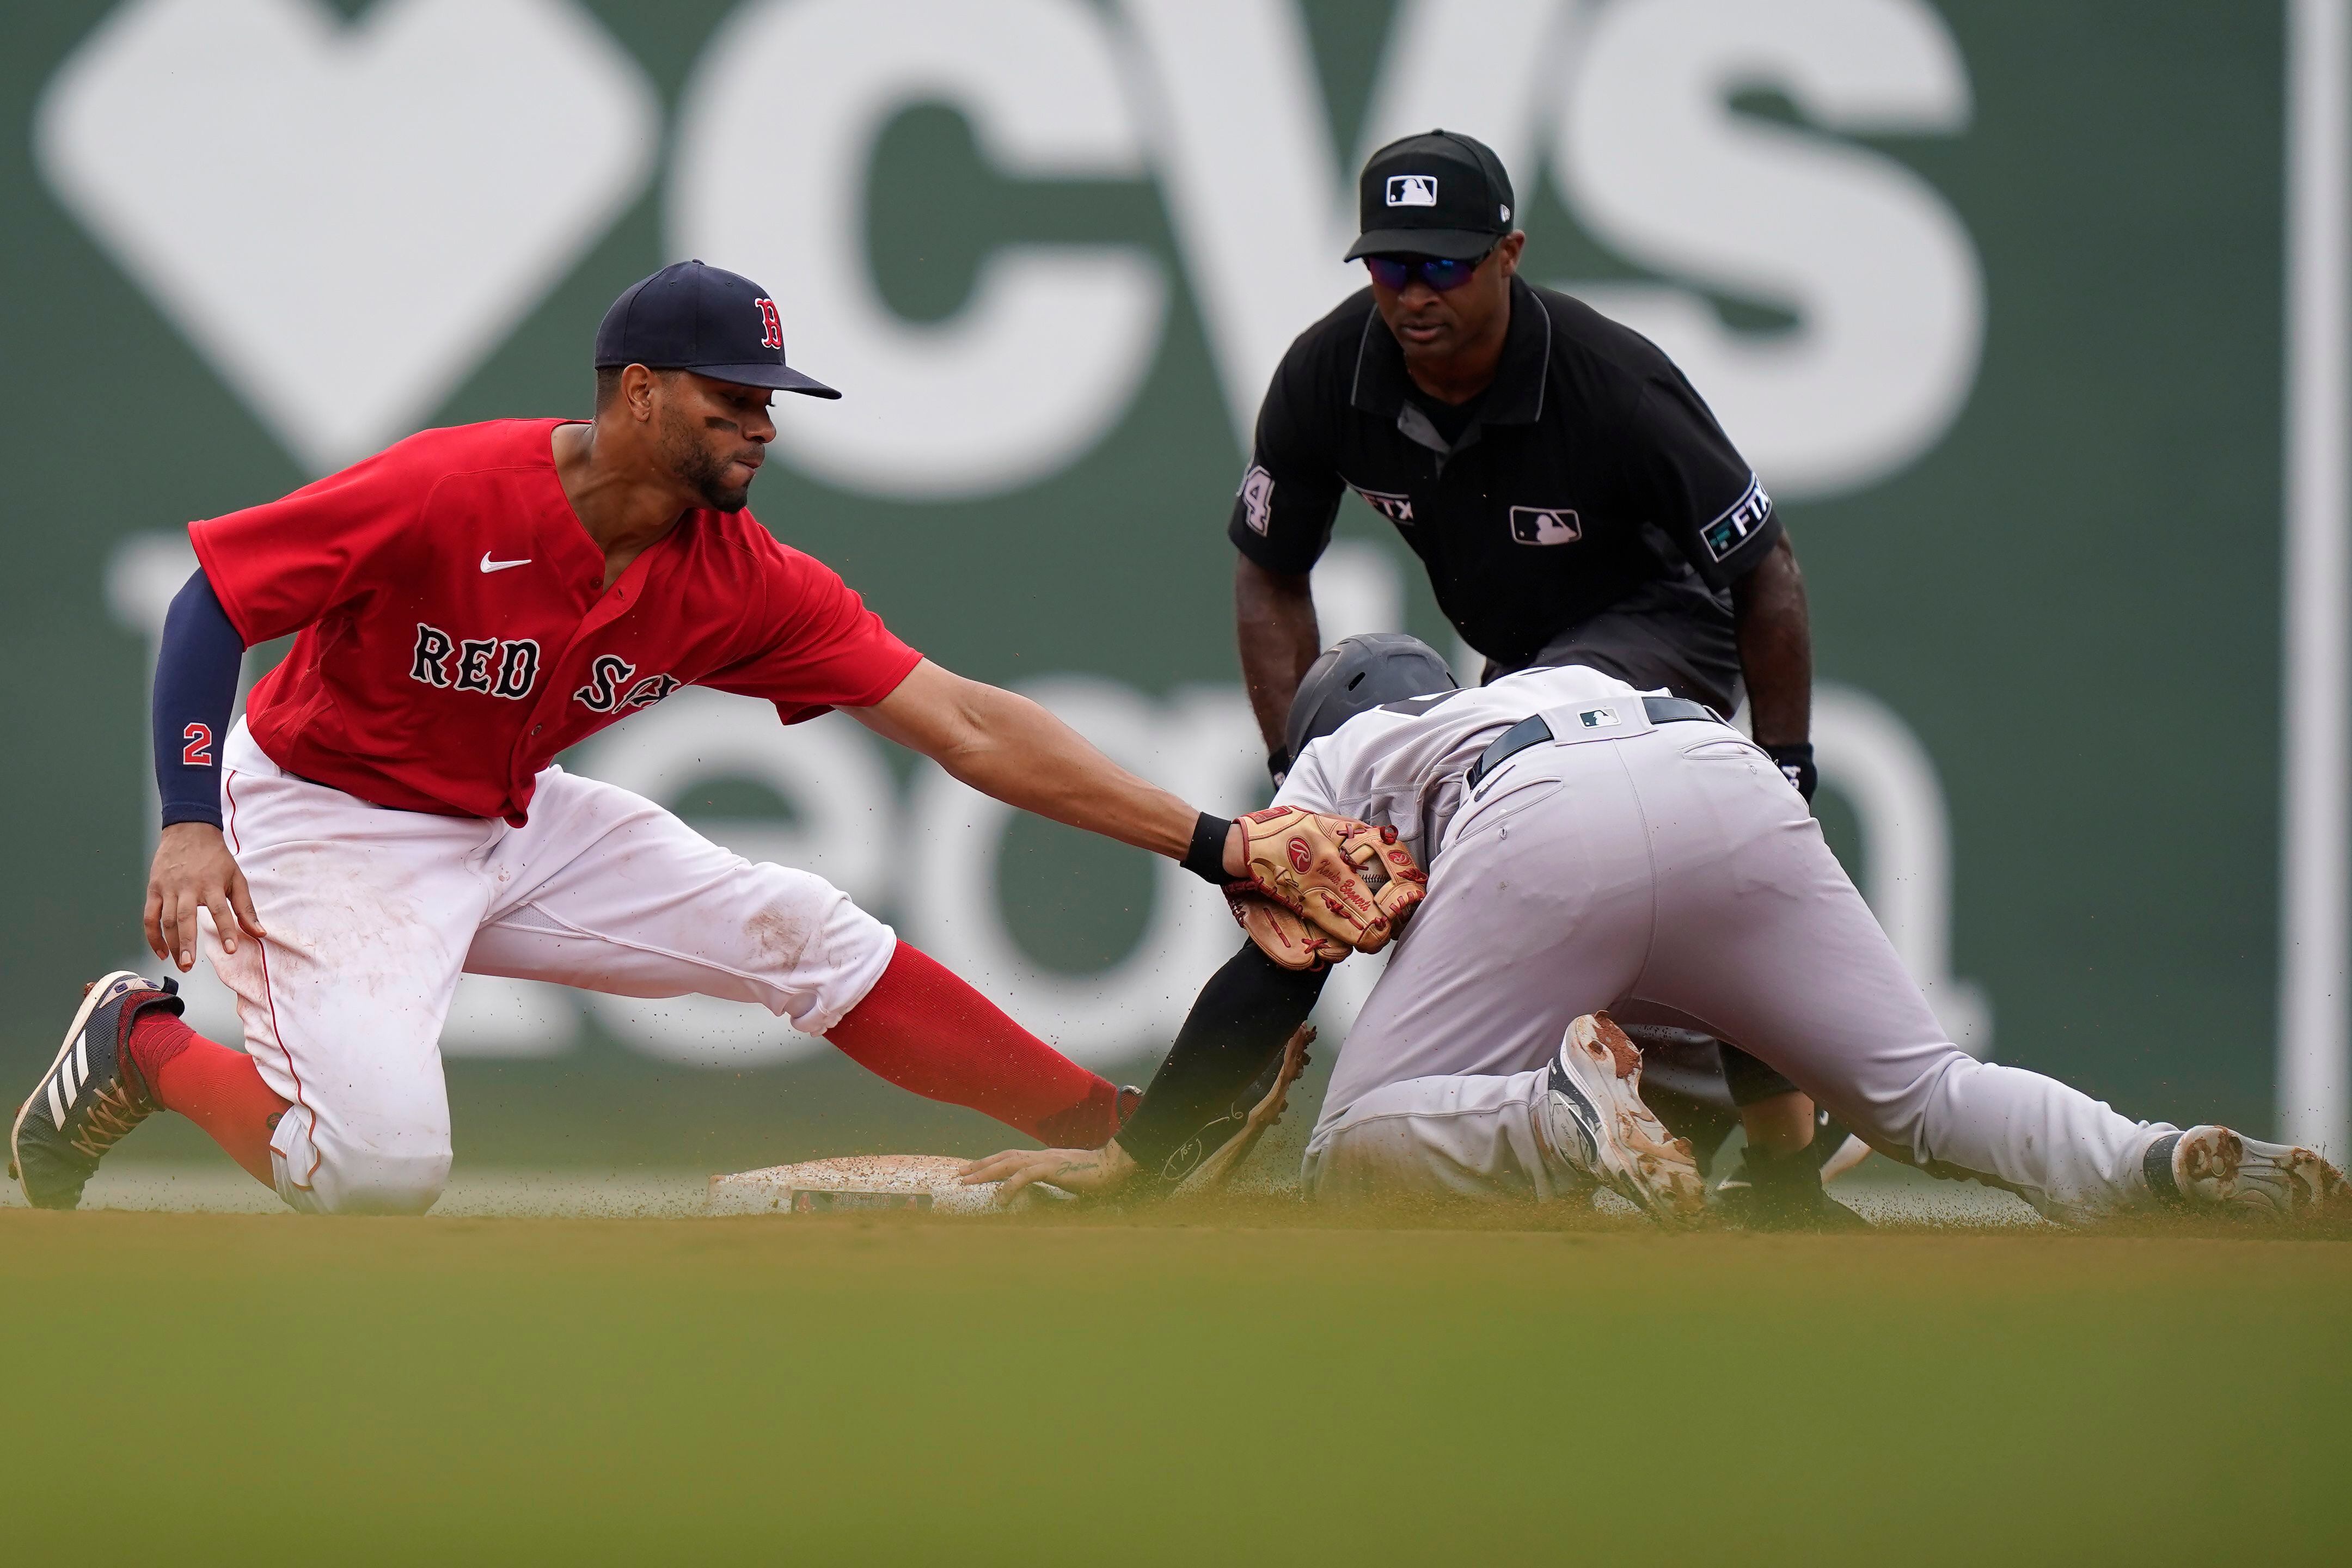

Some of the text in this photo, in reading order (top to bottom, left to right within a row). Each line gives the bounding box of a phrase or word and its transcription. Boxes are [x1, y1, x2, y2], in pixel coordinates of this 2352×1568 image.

[669, 0, 1987, 500] CVS
[755, 297, 782, 350] B
[1236, 452, 1276, 537] 4
[1731, 479, 1769, 537] FTX
[409, 623, 540, 700] RED
[183, 722, 212, 766] 2
